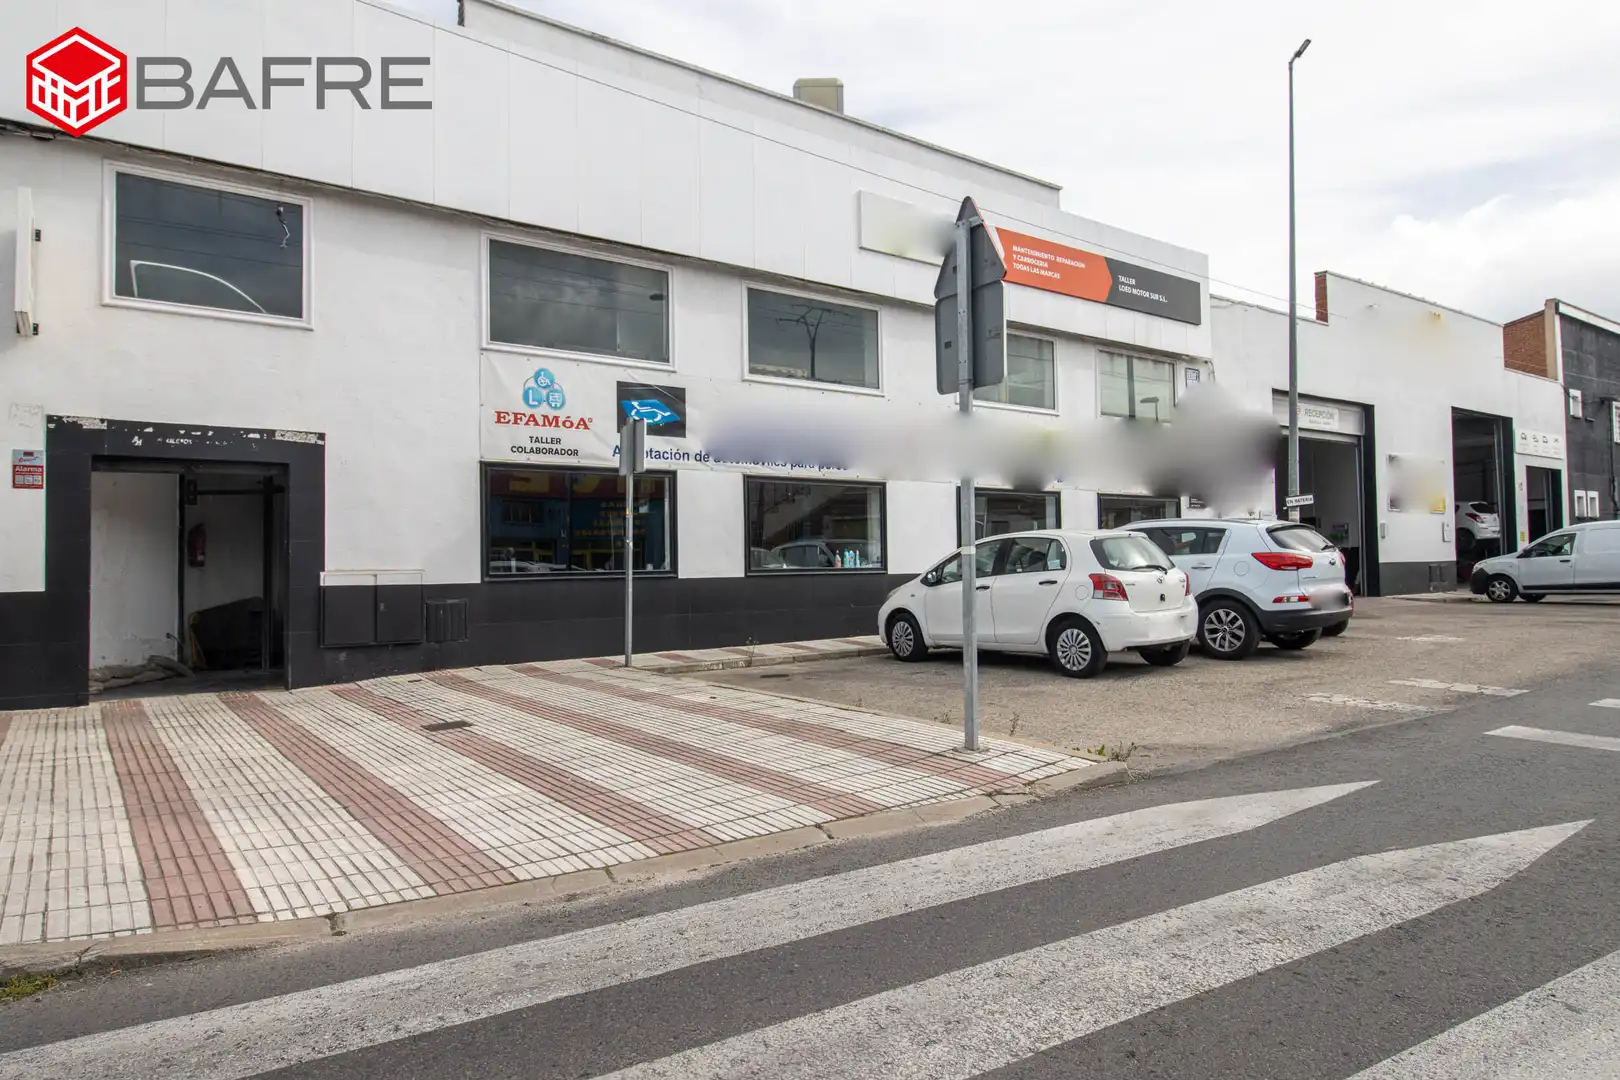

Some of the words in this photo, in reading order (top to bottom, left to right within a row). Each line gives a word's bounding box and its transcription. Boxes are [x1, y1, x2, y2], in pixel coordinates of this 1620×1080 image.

[1013, 262, 1030, 273] TODAS
[1030, 267, 1040, 275] LAS
[1039, 269, 1061, 279] MARCAS
[1118, 275, 1136, 286] TALLER
[1132, 288, 1150, 299] MOTOR
[1150, 292, 1159, 301] SUR
[529, 435, 562, 445] TALLER
[510, 445, 579, 457] COLABORADOR
[612, 444, 690, 462] Atación
[694, 449, 710, 463] de
